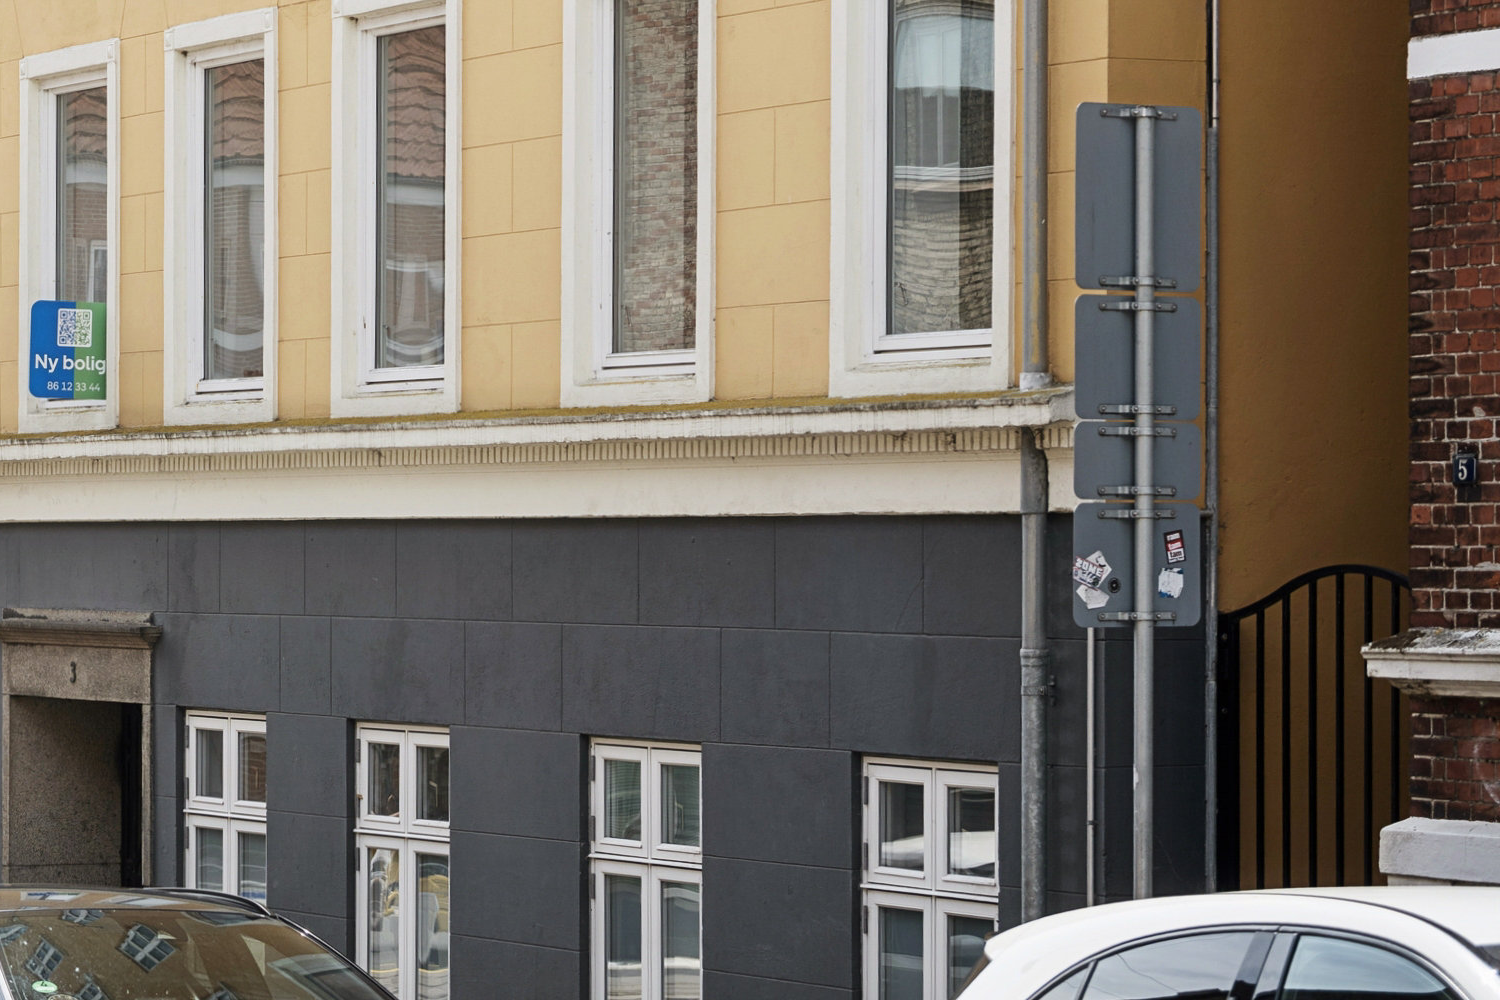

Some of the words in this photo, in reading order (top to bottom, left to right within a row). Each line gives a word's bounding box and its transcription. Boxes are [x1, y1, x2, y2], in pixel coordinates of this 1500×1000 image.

[34, 354, 59, 373] Ny
[62, 355, 106, 375] bolig
[47, 381, 59, 391] 86
[61, 381, 73, 392] 12
[75, 382, 87, 392] 33
[89, 382, 101, 392] 44
[1458, 459, 1468, 480] 5
[70, 661, 77, 683] 3
